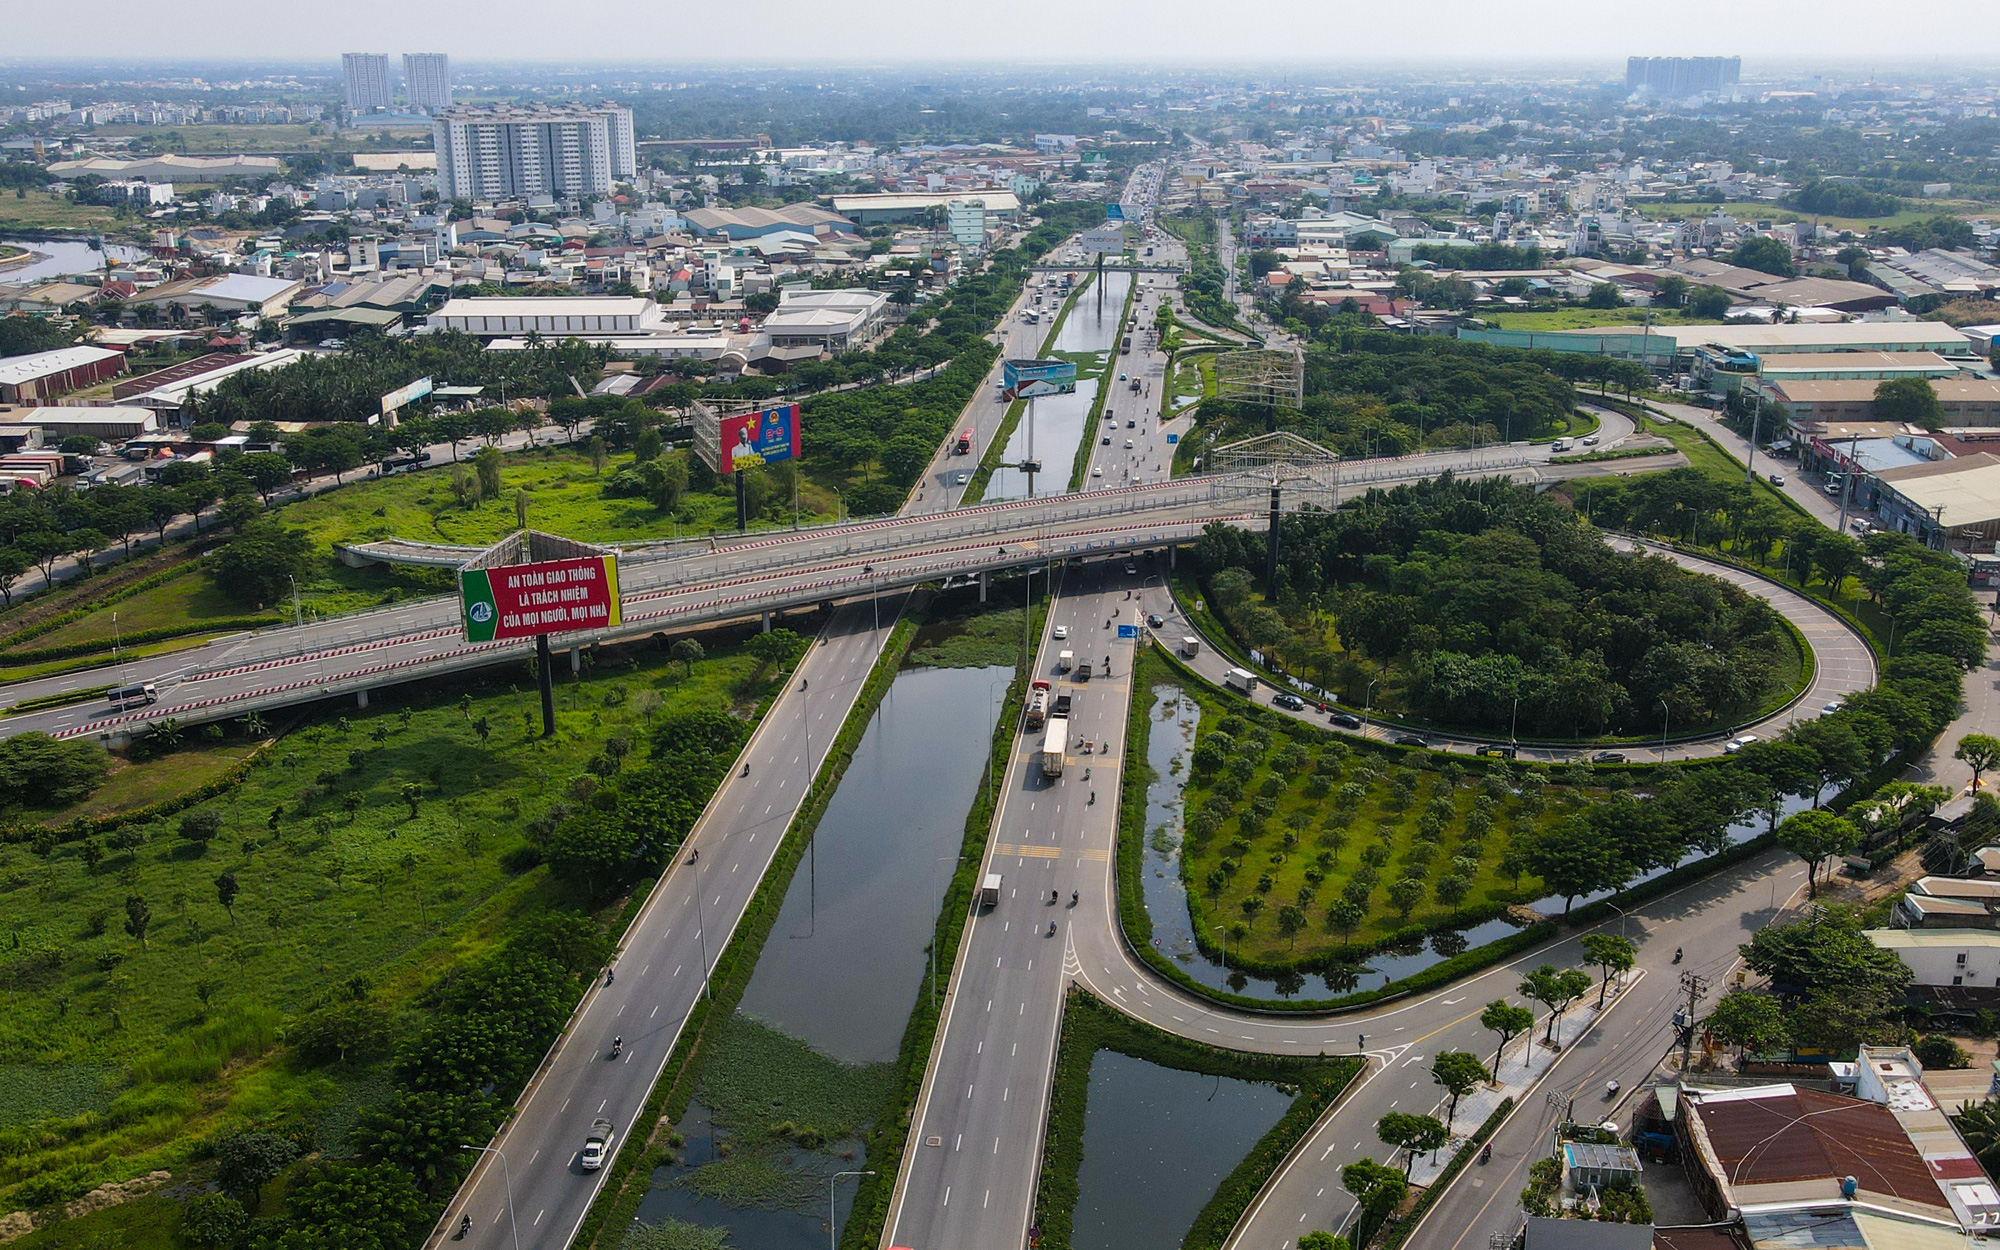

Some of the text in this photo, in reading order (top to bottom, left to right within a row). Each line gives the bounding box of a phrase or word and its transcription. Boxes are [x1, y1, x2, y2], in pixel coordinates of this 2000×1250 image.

[508, 565, 596, 589] AN TOÀN GIAO THÔNG
[518, 585, 589, 607] LÀ TRÁCH NHIỆM
[503, 601, 608, 628] CỦA MỌI NGƯỜI, MỌI NHÀ
